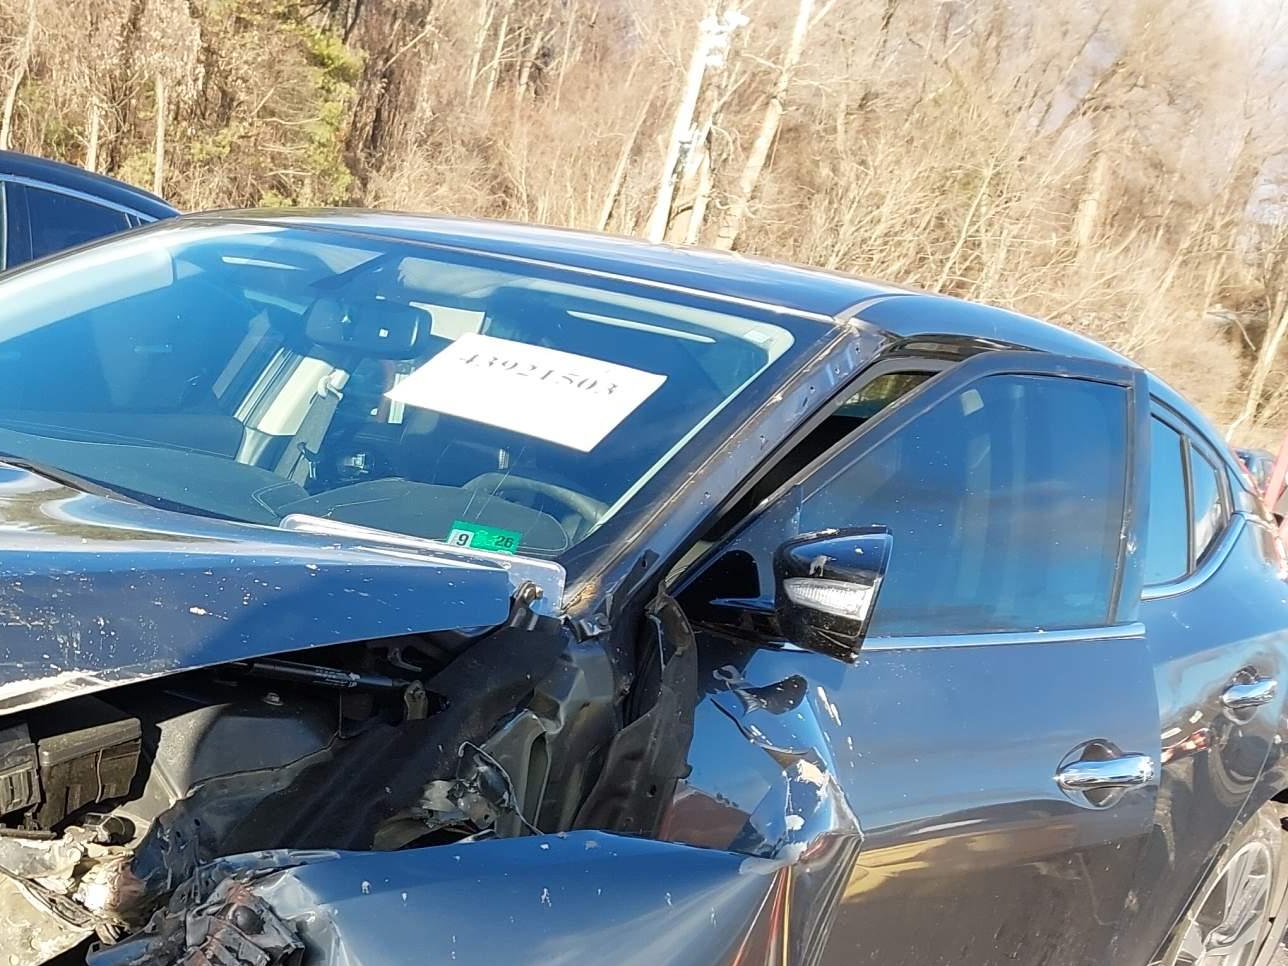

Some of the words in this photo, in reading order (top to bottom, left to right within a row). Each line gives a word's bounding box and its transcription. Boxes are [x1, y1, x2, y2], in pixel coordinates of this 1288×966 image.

[460, 354, 618, 395] 43921503
[456, 534, 469, 546] 9
[495, 535, 514, 548] 26
